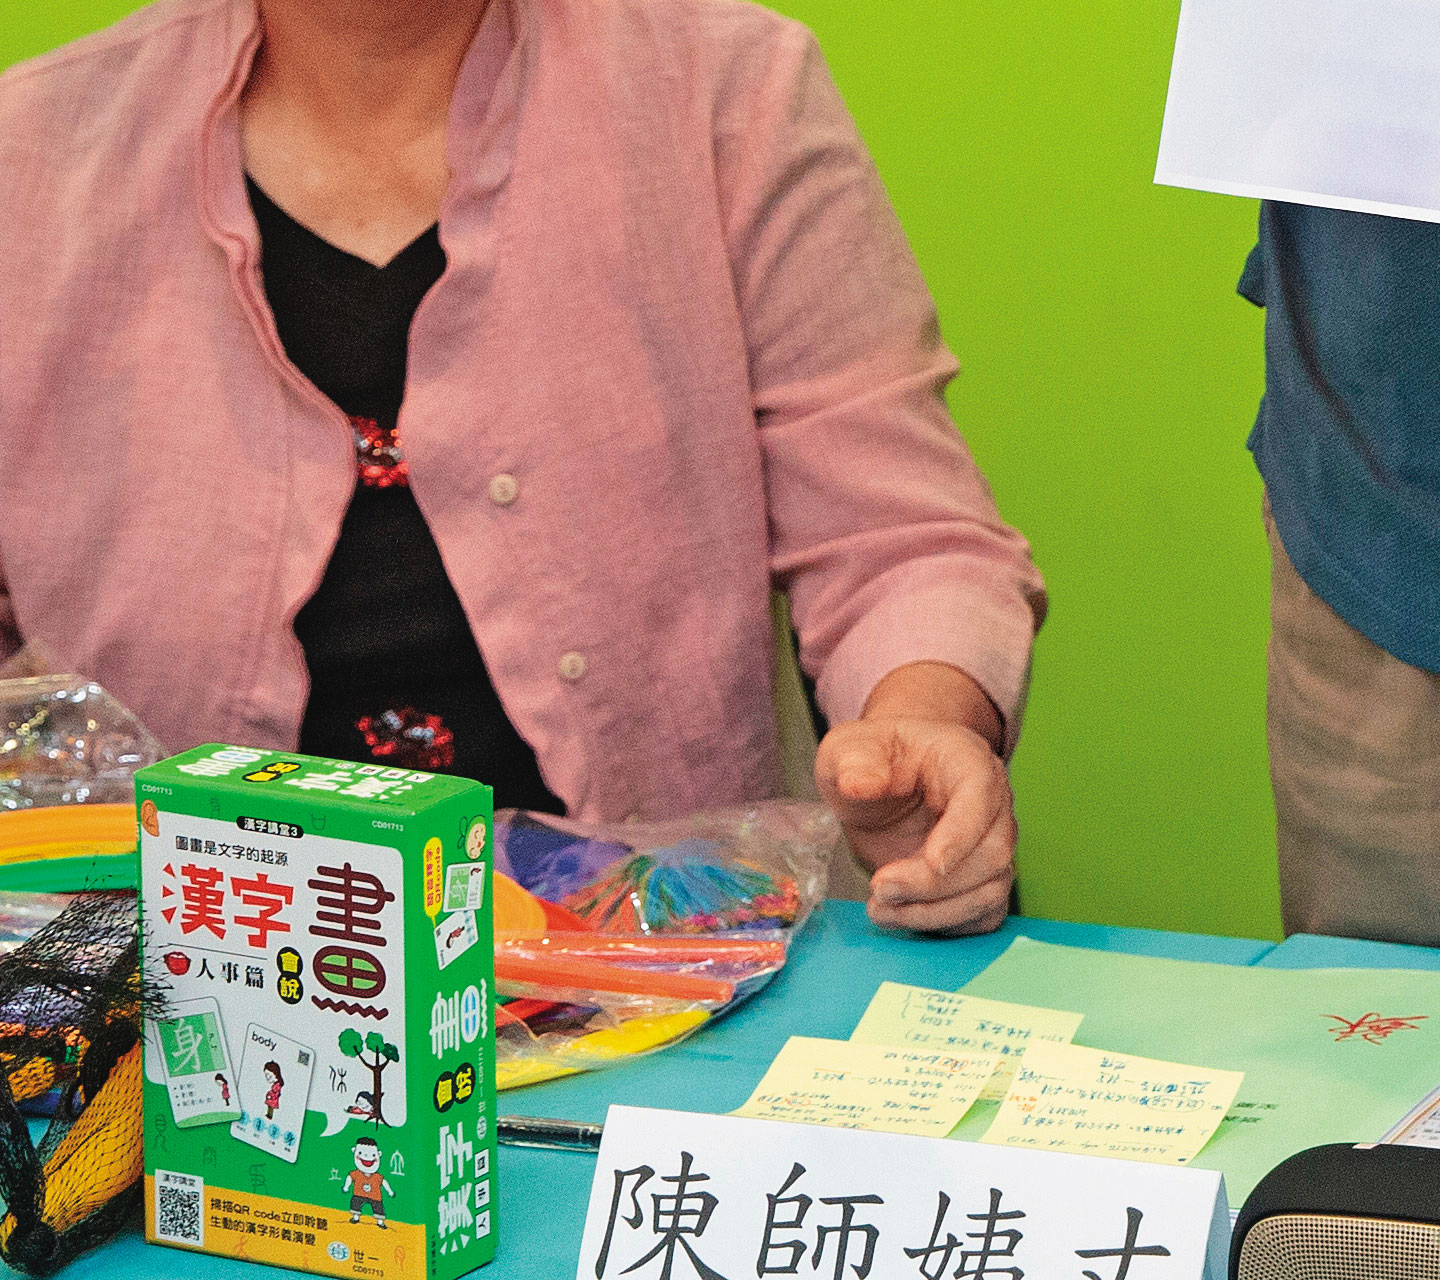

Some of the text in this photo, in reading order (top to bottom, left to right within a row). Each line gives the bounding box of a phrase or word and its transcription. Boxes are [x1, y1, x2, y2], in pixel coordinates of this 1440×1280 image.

[141, 783, 173, 795] CD01713
[371, 820, 404, 831] CD01713
[161, 863, 295, 949] 漢字
[196, 957, 265, 989] 人事篇
[171, 1018, 203, 1073] 身
[251, 1030, 277, 1051] body
